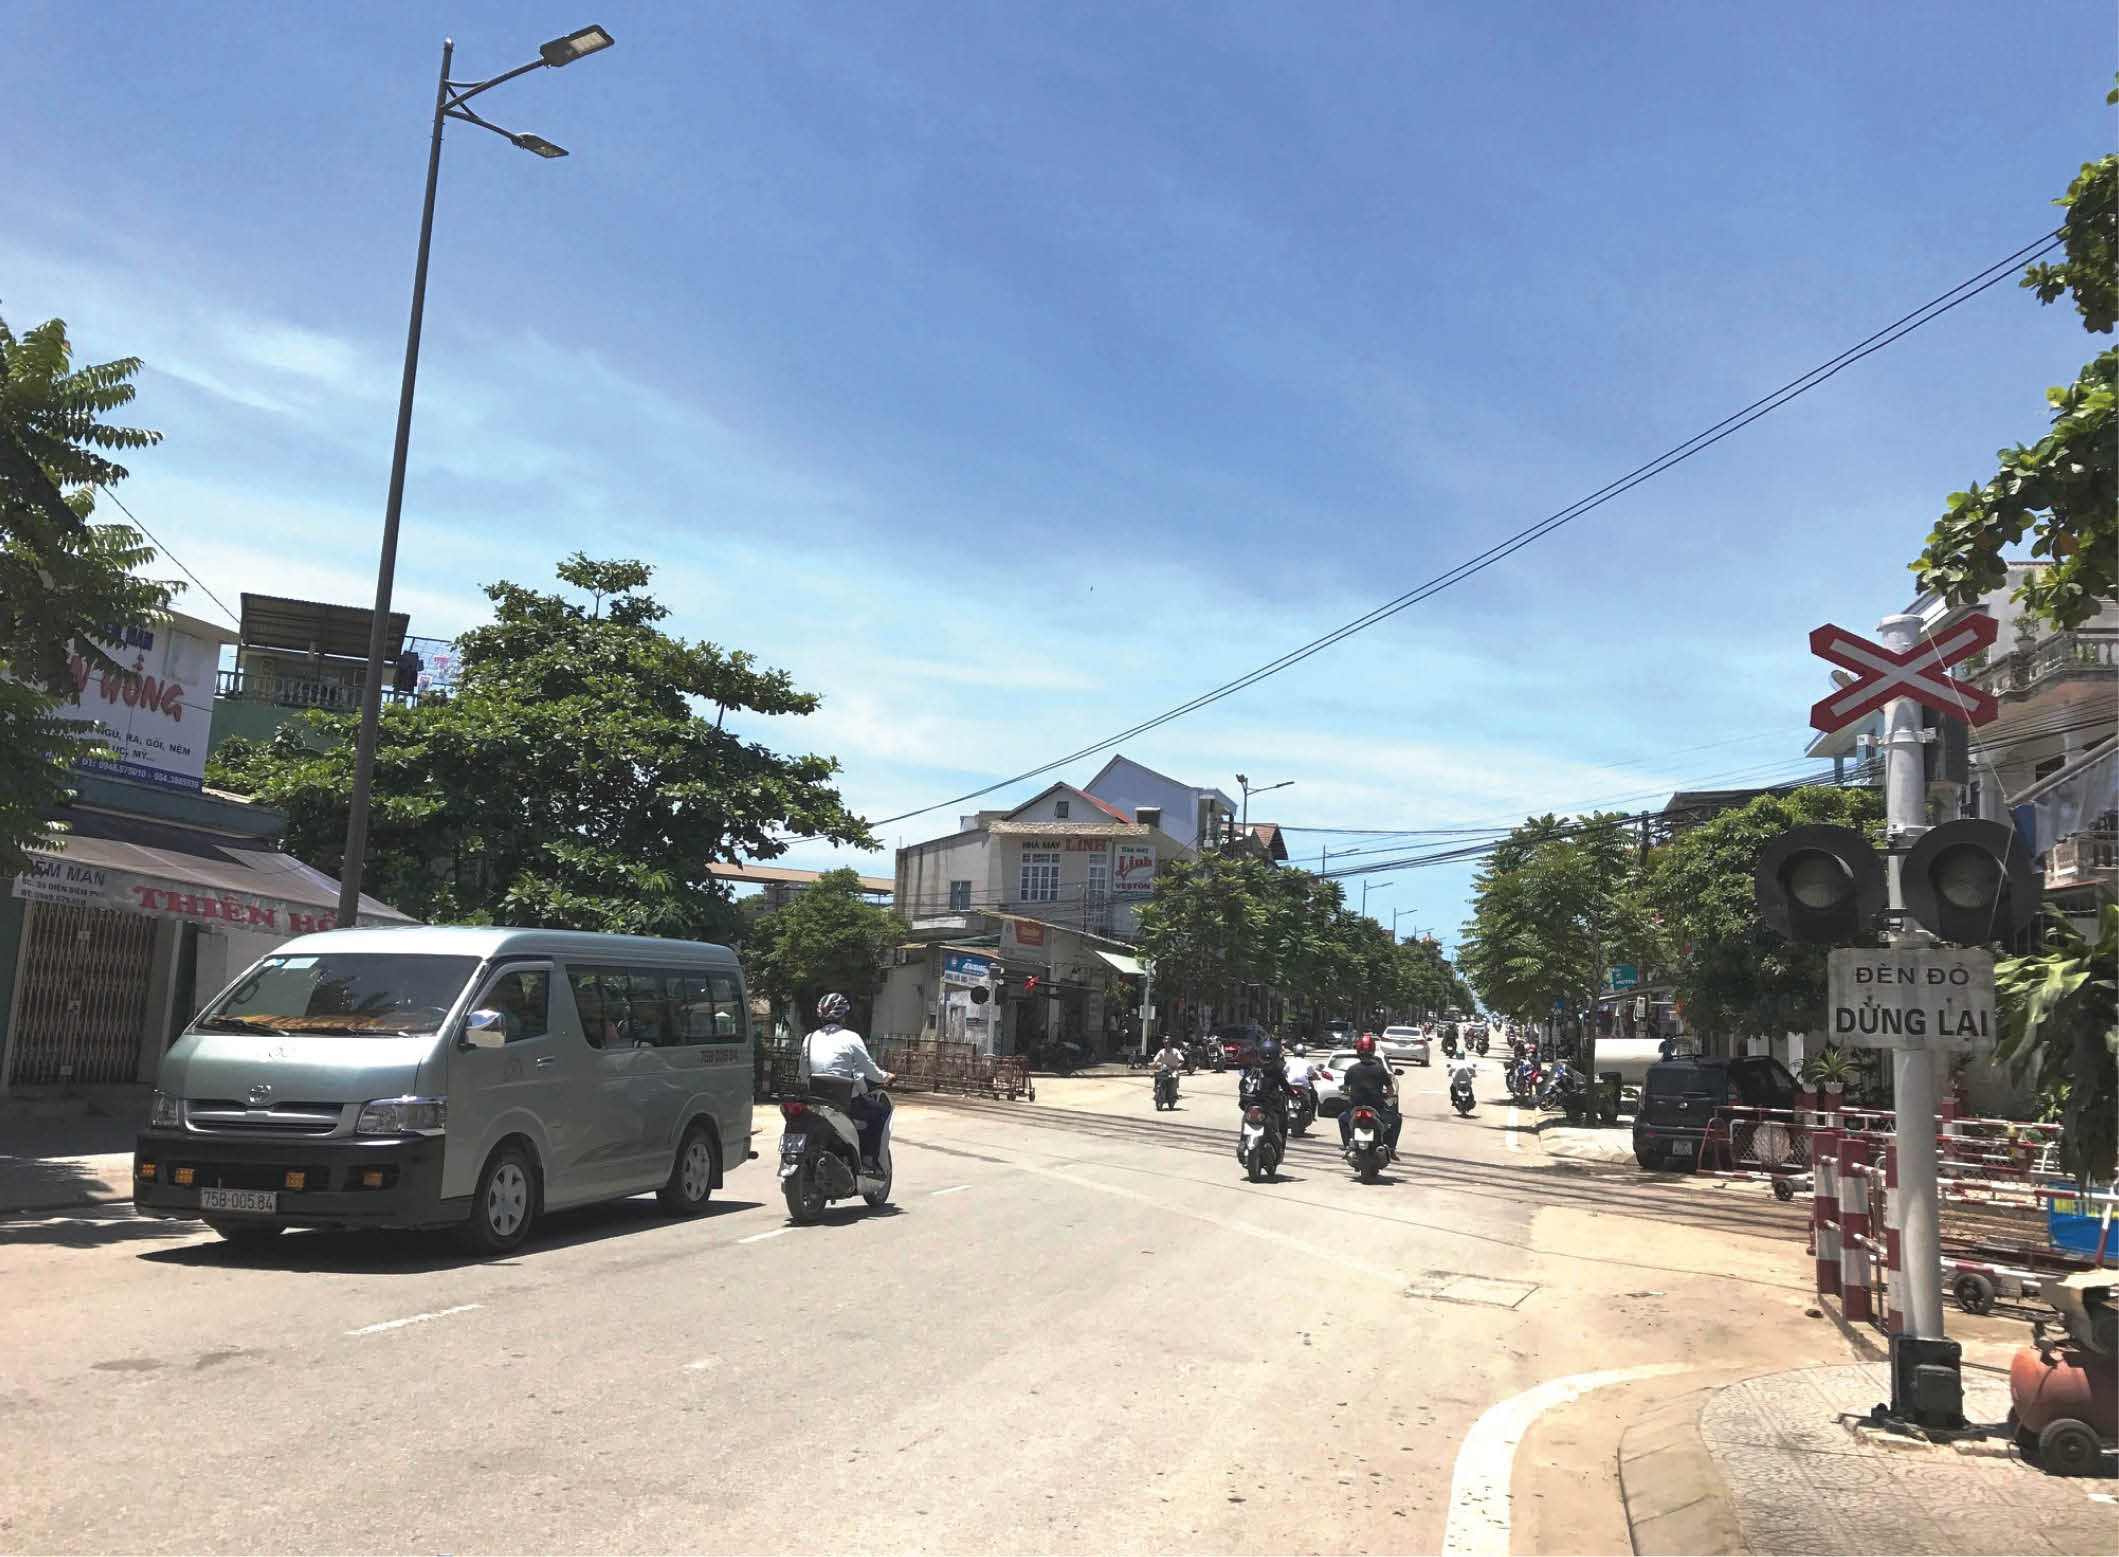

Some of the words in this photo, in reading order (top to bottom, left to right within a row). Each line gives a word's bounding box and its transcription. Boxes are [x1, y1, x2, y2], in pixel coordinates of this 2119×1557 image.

[1855, 962, 1915, 985] ĐÈN
[1926, 961, 1969, 985] ĐỎ
[1836, 999, 1926, 1035] DỪNG
[1938, 1008, 1989, 1042] LẠI
[203, 1191, 273, 1210] 75B-005.84
